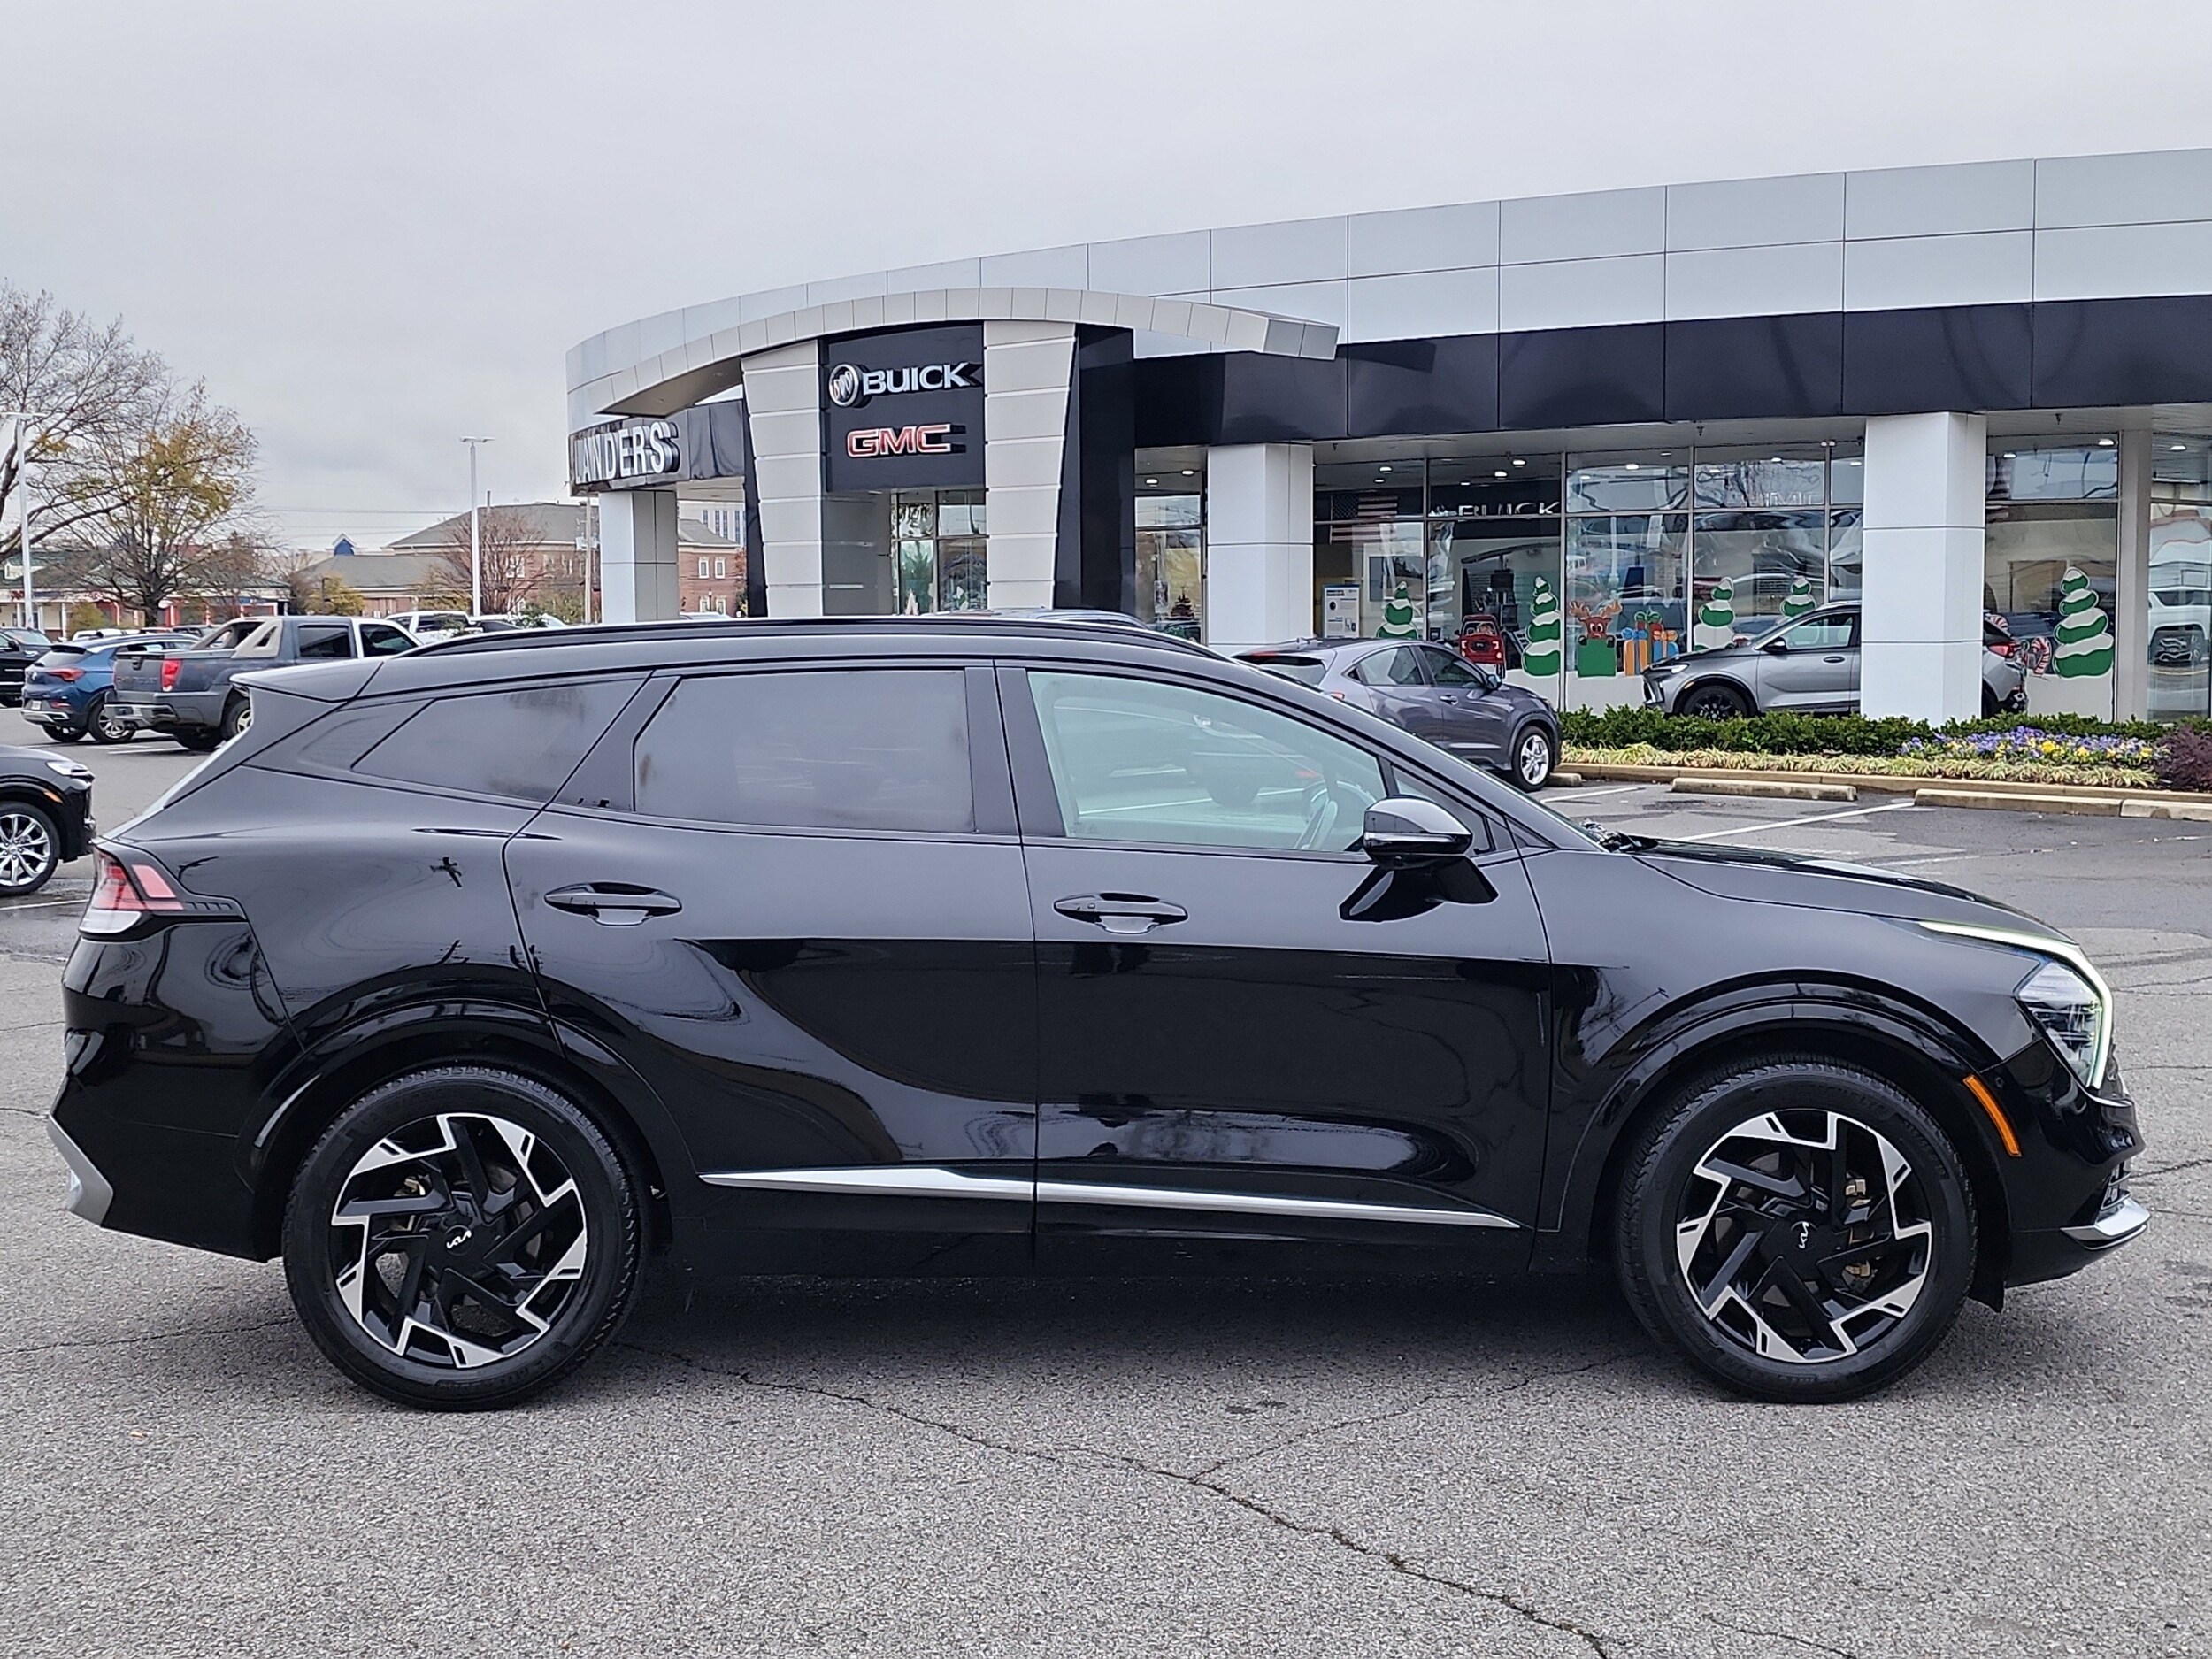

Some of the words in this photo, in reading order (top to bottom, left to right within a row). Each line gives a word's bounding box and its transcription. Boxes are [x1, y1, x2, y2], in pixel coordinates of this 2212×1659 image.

[863, 362, 971, 396] BUICK
[573, 421, 666, 485] LANDERS
[847, 423, 951, 457] GMC
